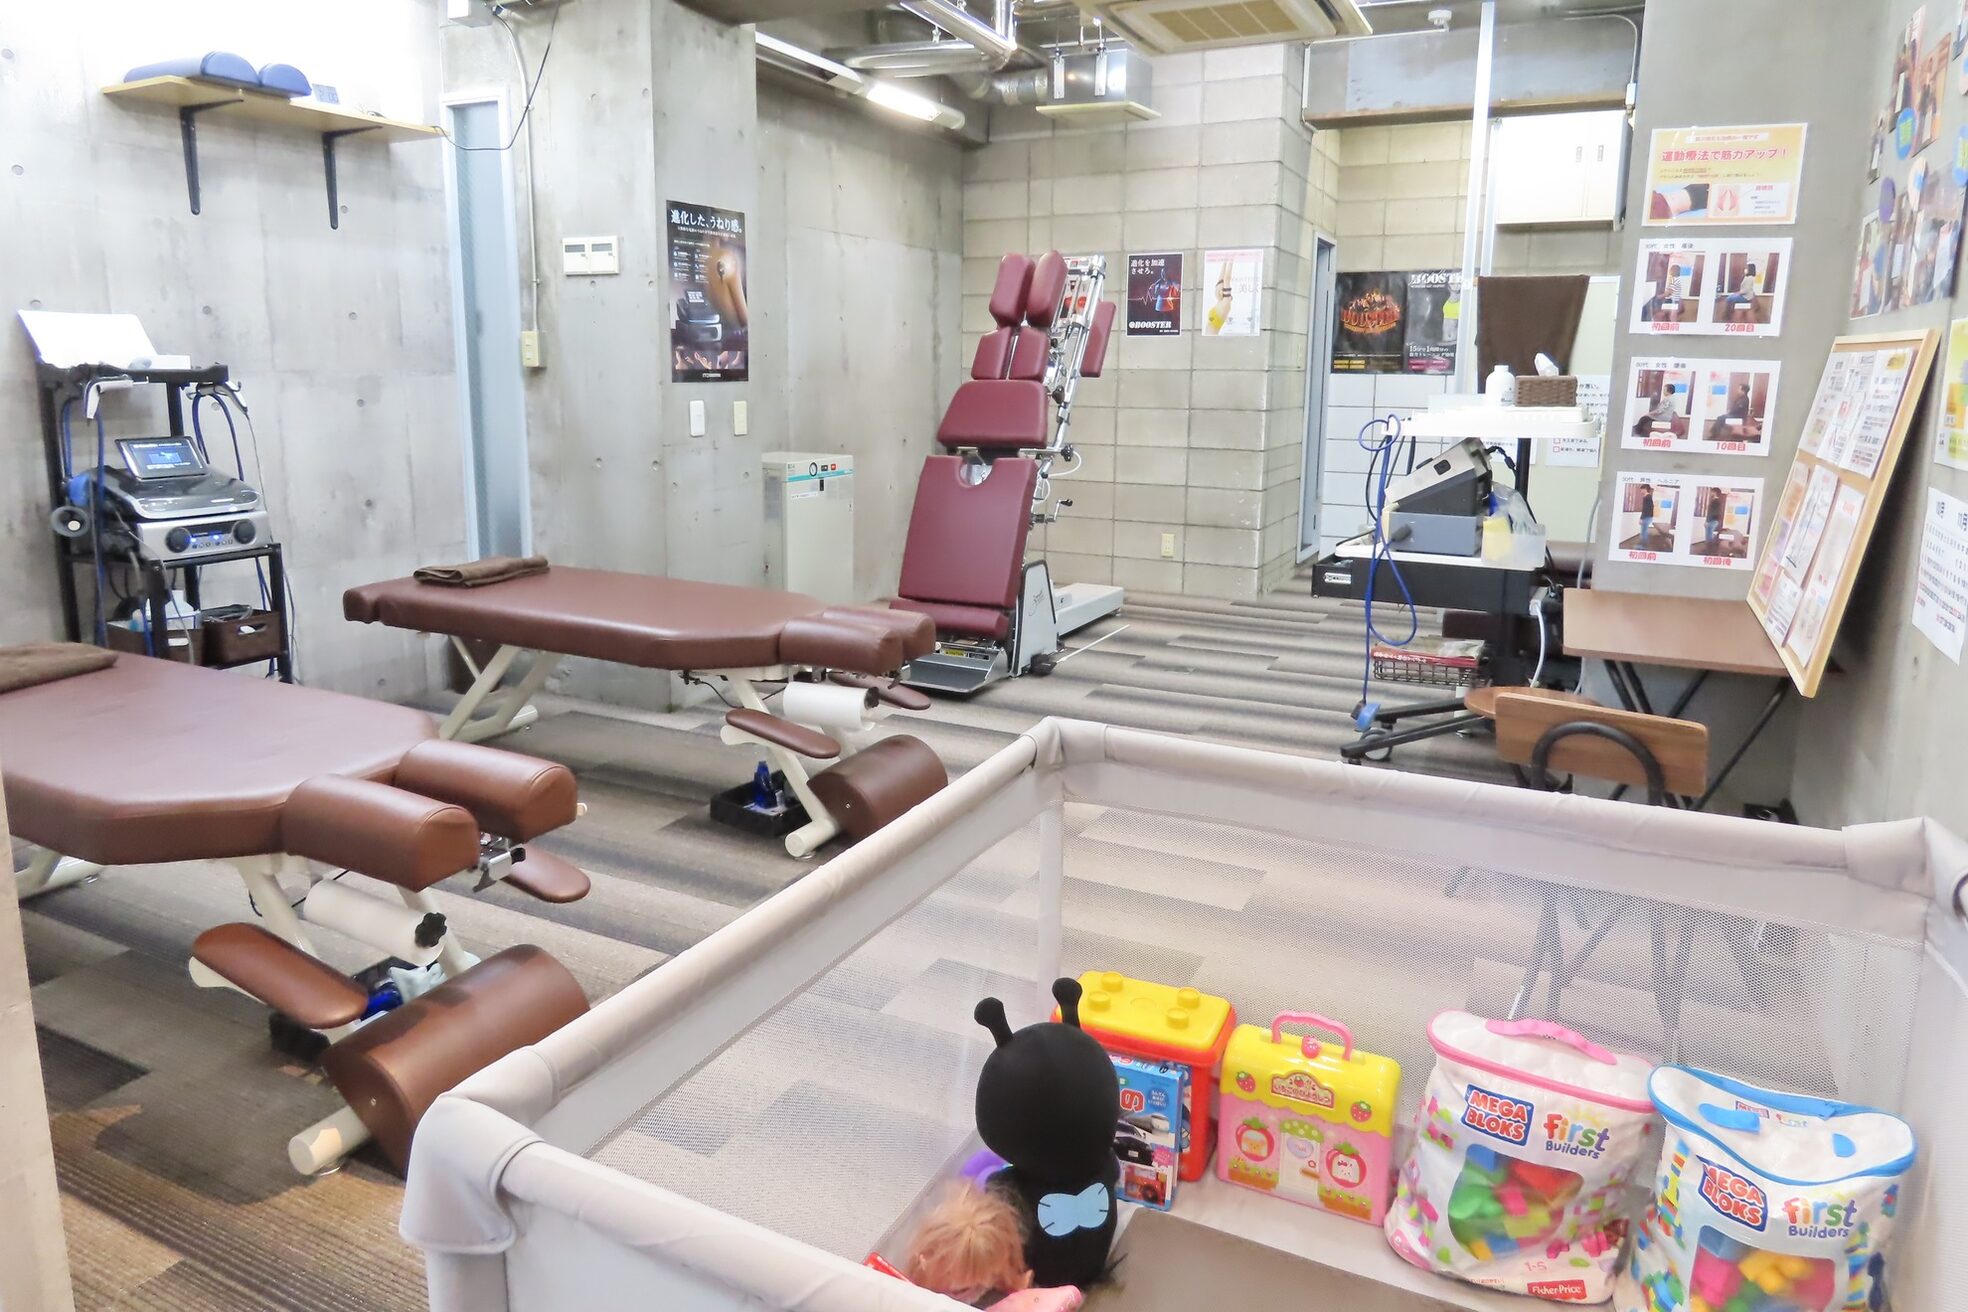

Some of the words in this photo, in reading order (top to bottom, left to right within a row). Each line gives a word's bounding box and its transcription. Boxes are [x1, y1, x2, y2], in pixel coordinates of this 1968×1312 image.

[670, 209, 742, 233] 進化した、うねり感。
[1468, 1090, 1528, 1123] MEGA
[1465, 1107, 1526, 1141] BLOKS
[1545, 1140, 1601, 1160] Builders
[1702, 1176, 1763, 1226] BLOKS
[1788, 1225, 1850, 1239] Builders
[1532, 1284, 1582, 1295] Fisher-Price
